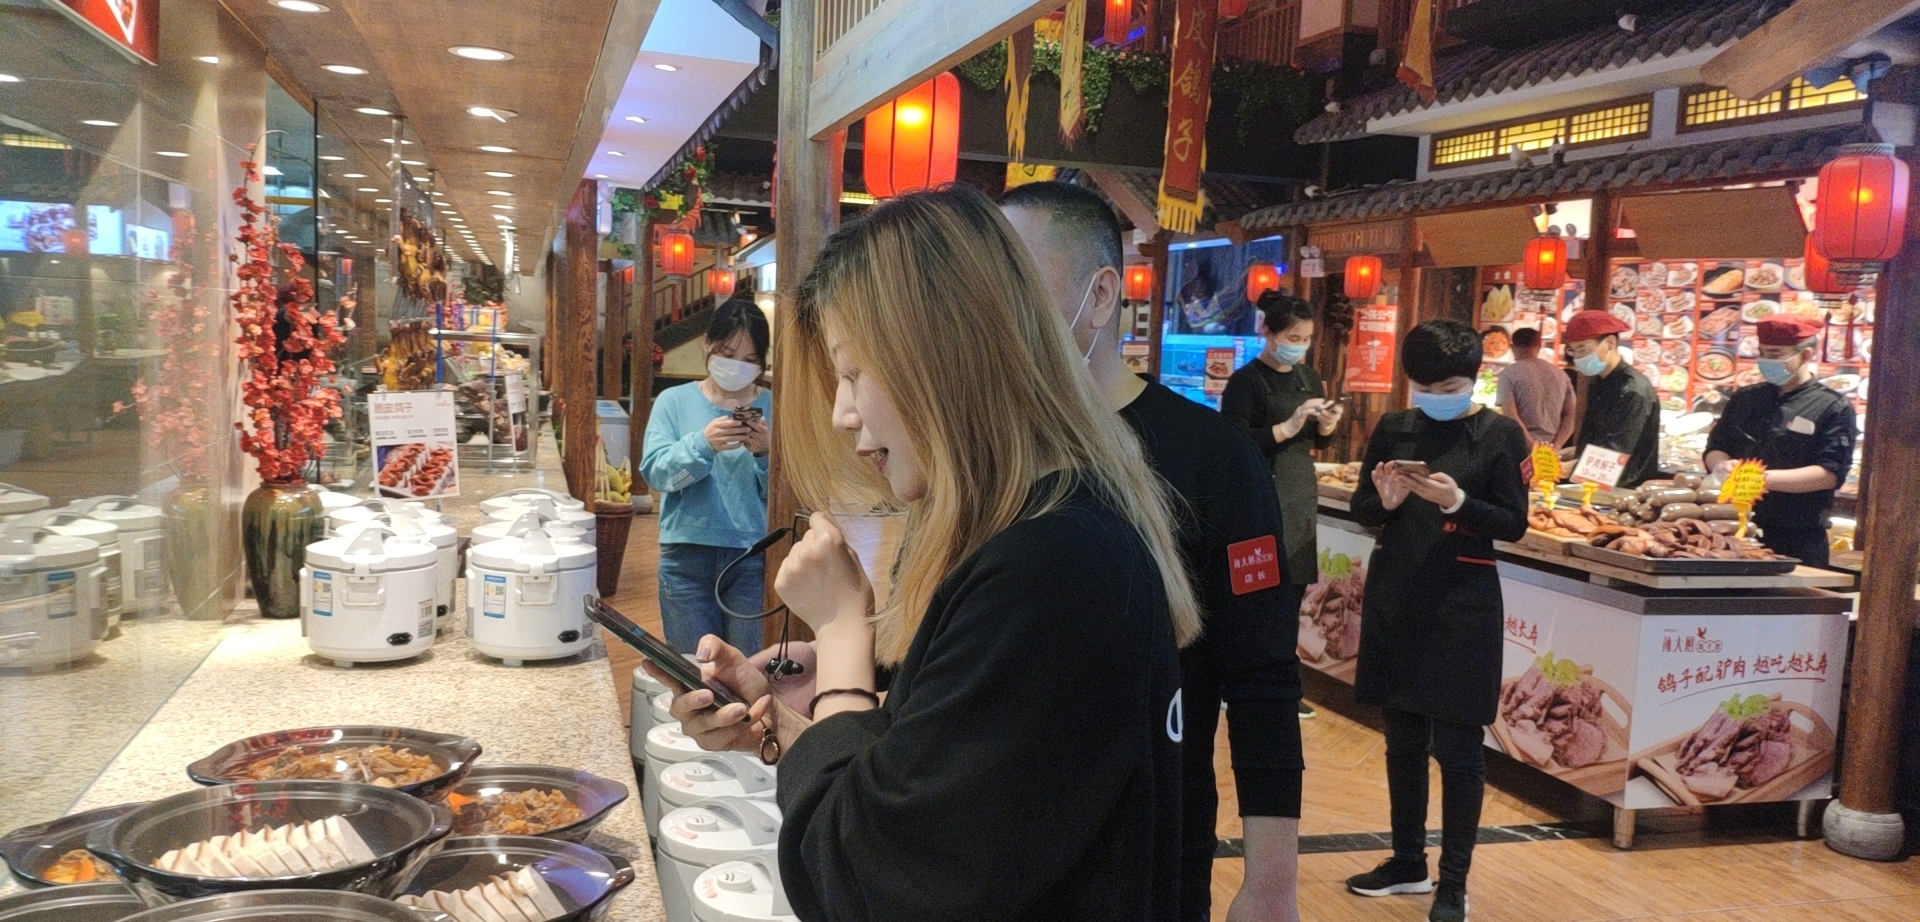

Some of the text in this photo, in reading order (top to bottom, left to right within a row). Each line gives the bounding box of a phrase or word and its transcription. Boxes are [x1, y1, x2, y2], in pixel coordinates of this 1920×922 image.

[1505, 614, 1538, 646] 越长寿
[1657, 651, 1828, 693] 鸽子配驴肉 越吃越长寿
